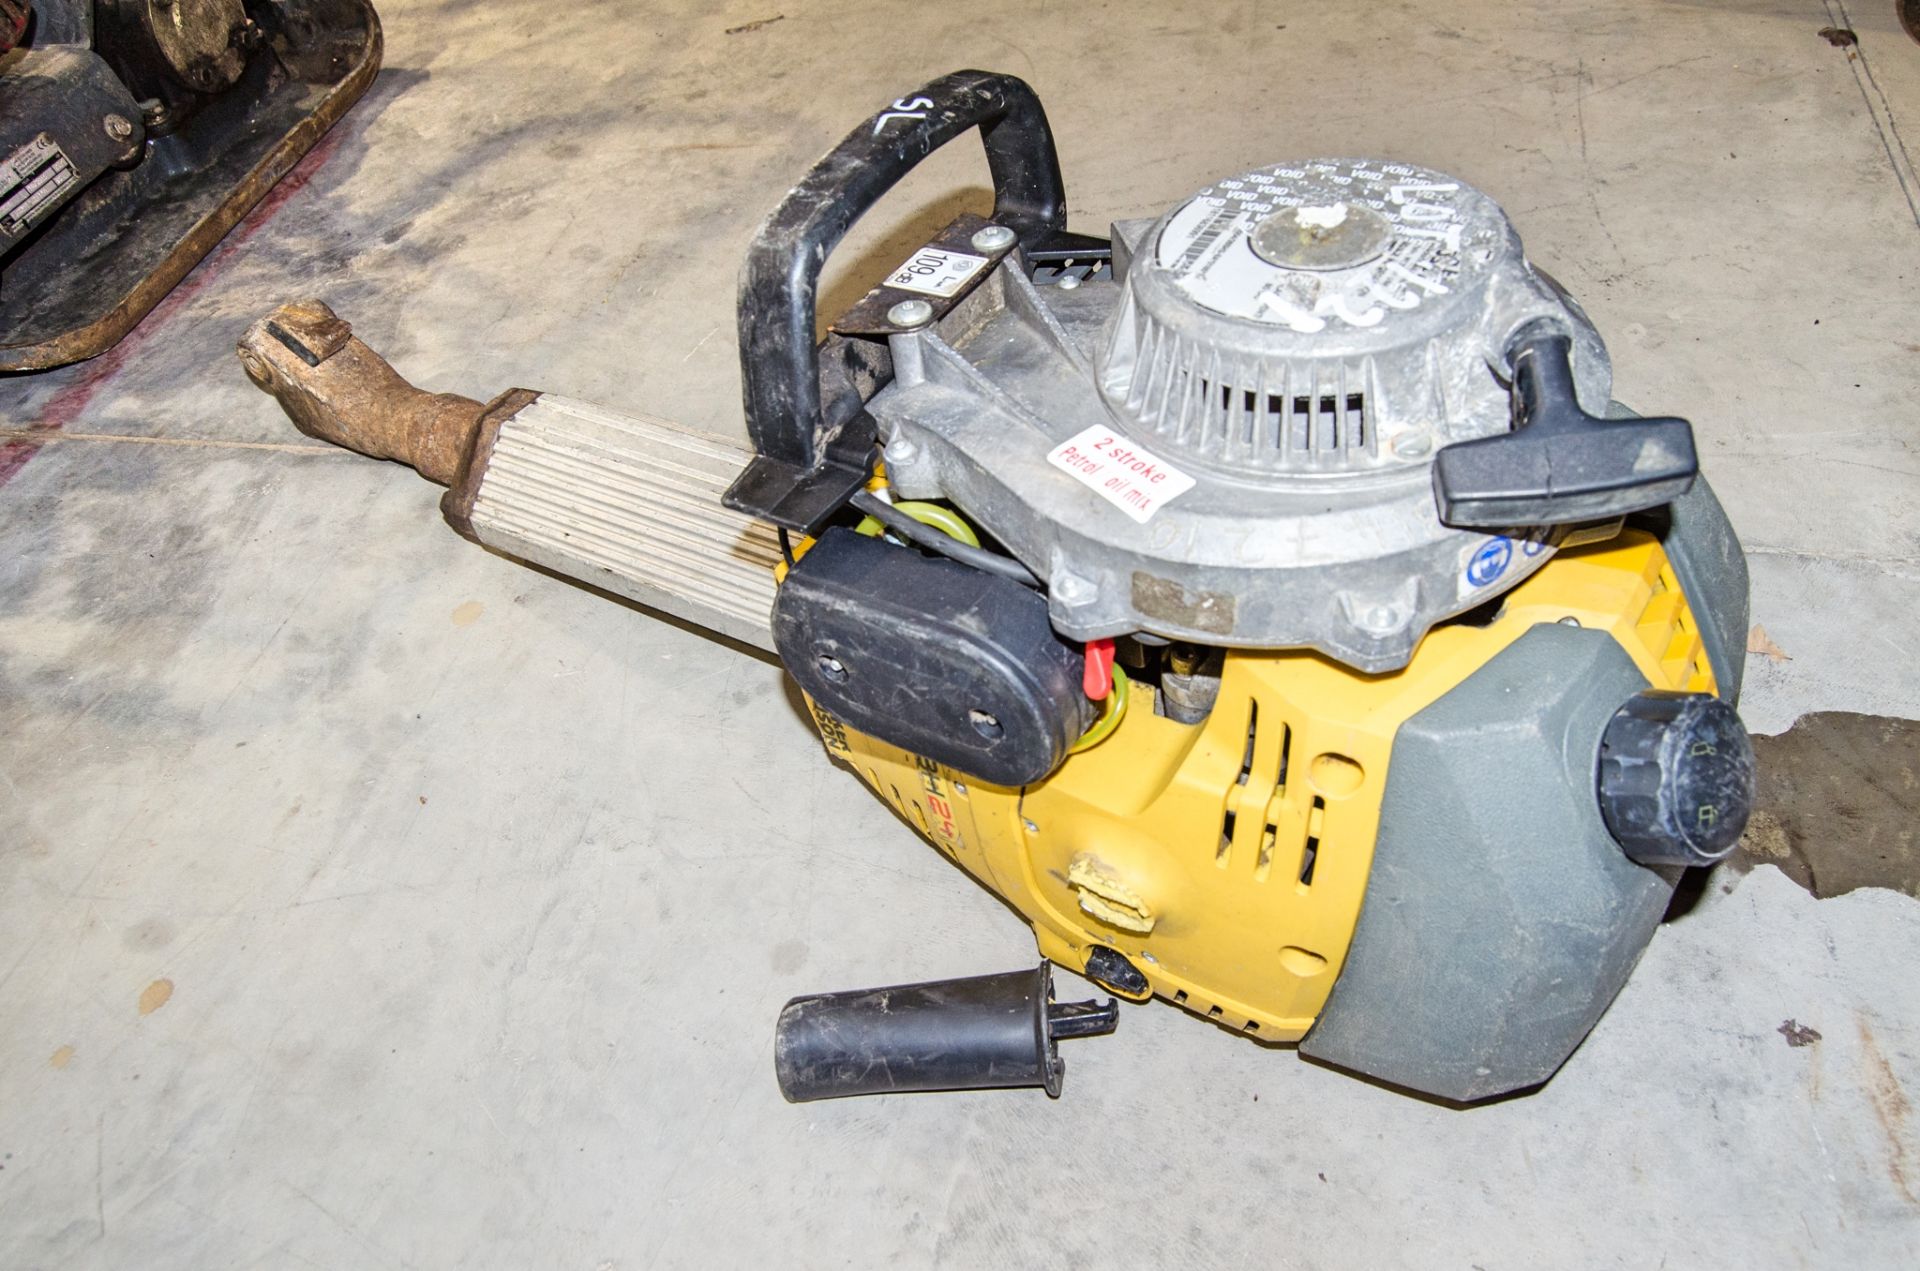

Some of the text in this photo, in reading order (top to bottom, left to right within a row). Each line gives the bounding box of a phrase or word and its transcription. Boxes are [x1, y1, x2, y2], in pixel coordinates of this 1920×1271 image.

[1274, 168, 1305, 178] VOID
[1351, 169, 1384, 180] VOID
[1257, 184, 1289, 195] VOID
[1226, 190, 1258, 201] VOID
[1240, 201, 1273, 212] VOID
[908, 253, 949, 275] 109
[1093, 437, 1167, 484] 2 stroke
[1058, 446, 1152, 512] Petrol oil mix
